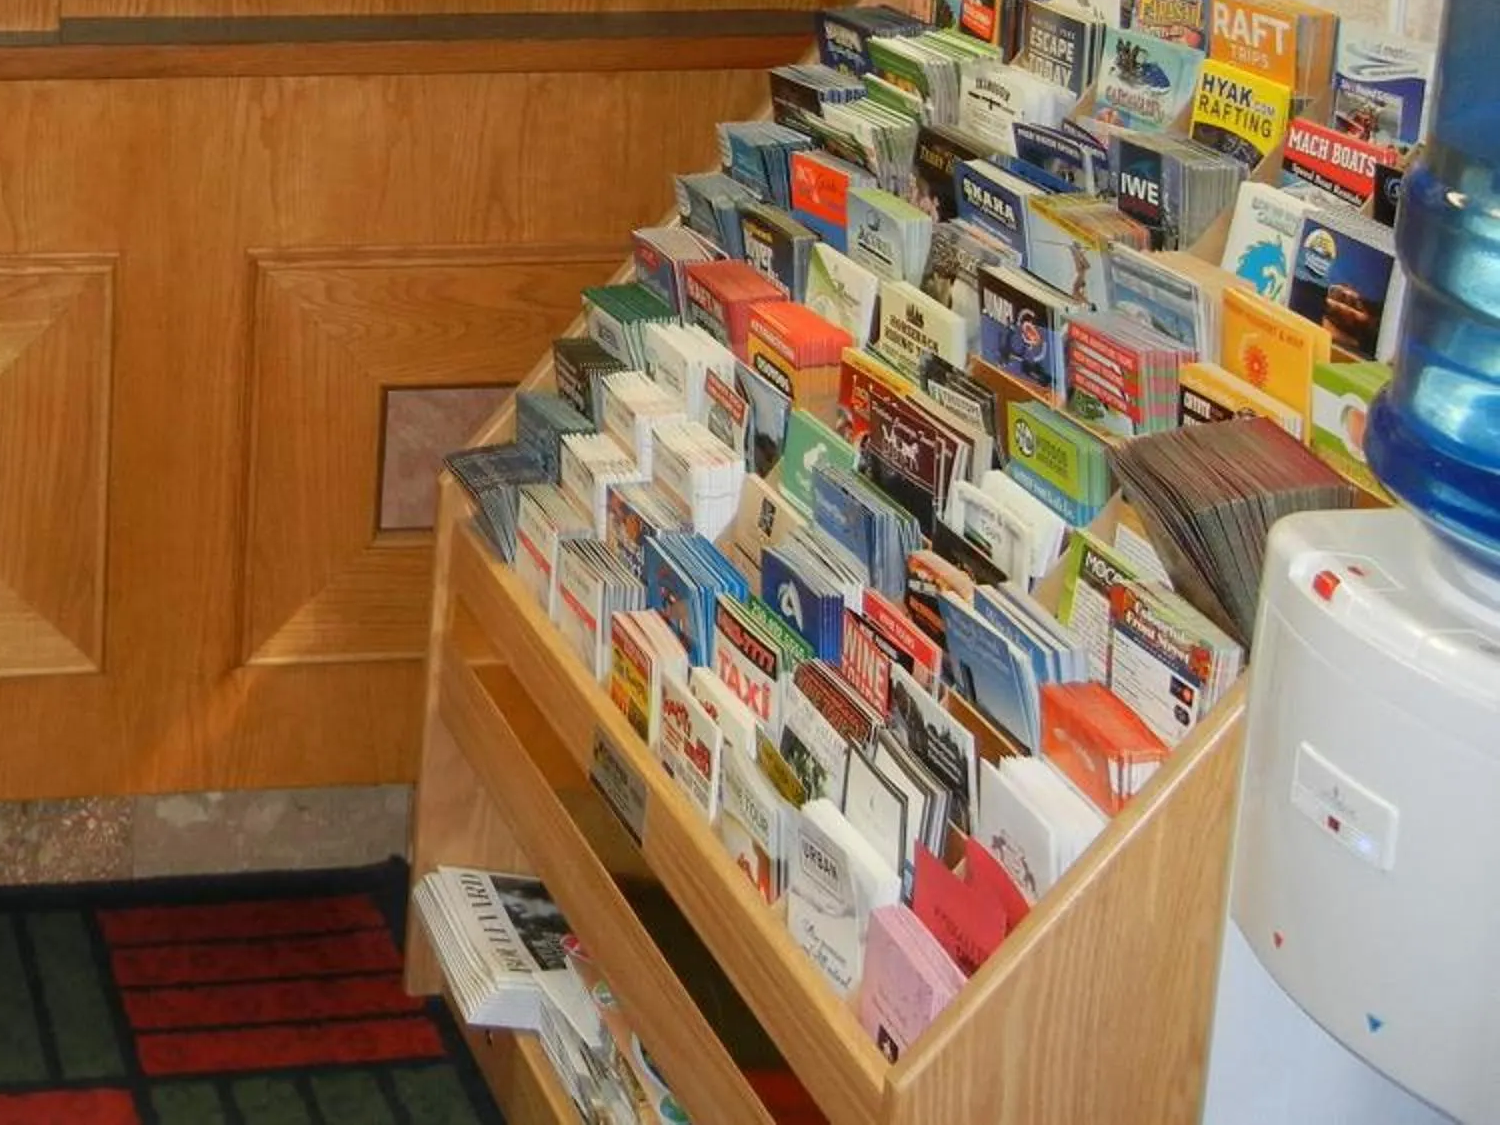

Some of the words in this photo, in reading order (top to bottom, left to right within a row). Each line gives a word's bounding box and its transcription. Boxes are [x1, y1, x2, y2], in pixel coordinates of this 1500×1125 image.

[1029, 26, 1075, 63] ESCAPE
[1213, 0, 1291, 56] RAFT
[1230, 43, 1269, 69] TRIPS
[1198, 94, 1272, 138] RAFTING
[1288, 127, 1329, 160] MACH
[1331, 142, 1377, 178] BOATS
[459, 873, 533, 973] BOULEVARD
